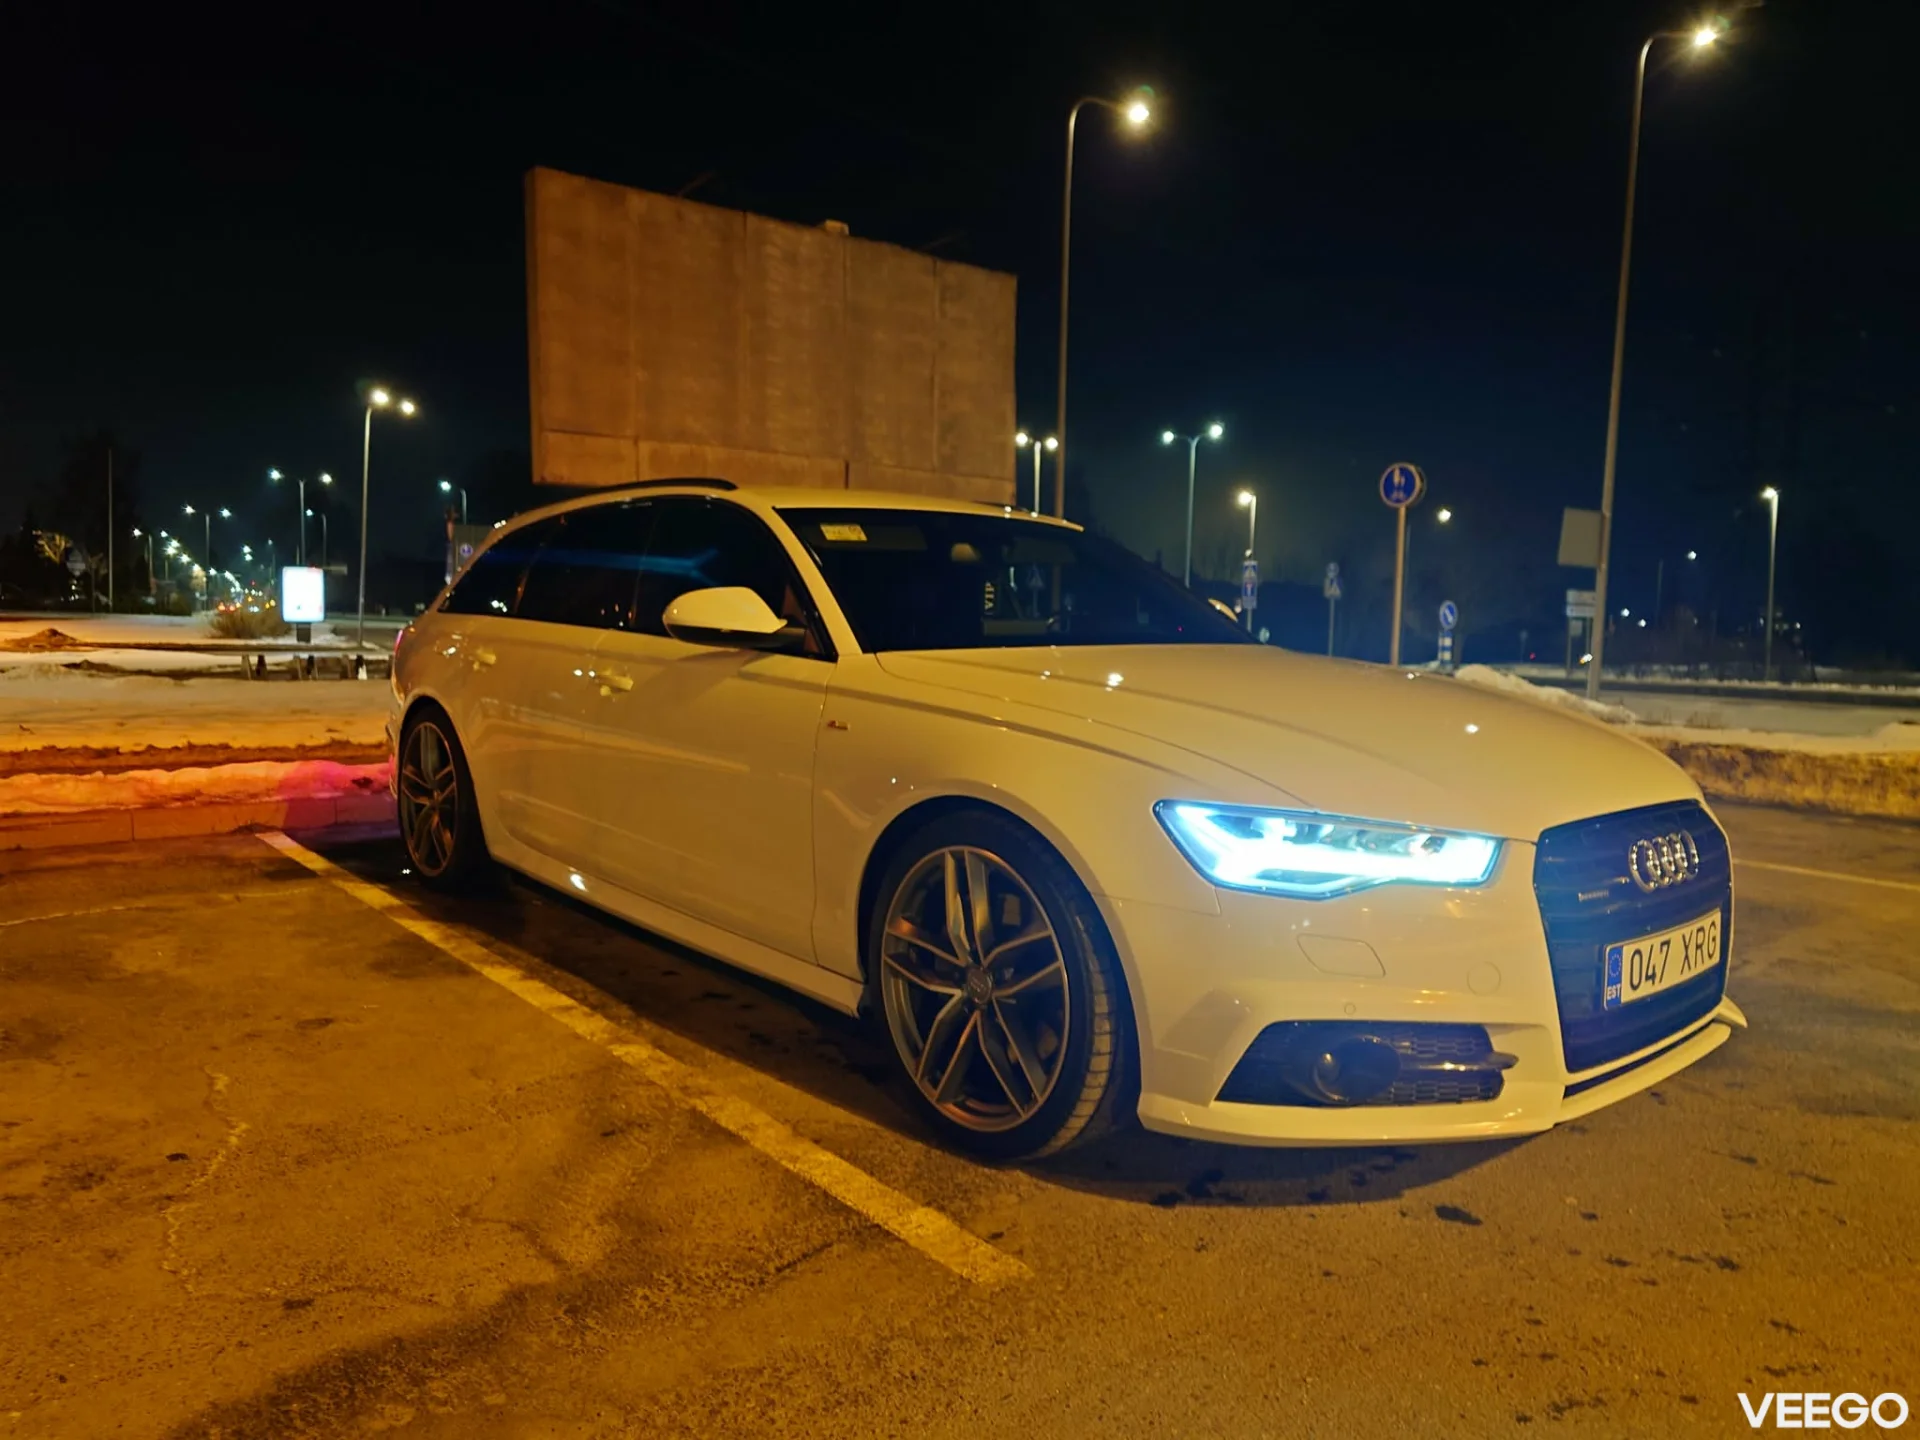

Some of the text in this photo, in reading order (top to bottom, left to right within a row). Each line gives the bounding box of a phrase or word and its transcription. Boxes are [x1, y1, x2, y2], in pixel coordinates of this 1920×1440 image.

[1630, 921, 1716, 990] 047 XRG
[1607, 984, 1621, 1000] EST
